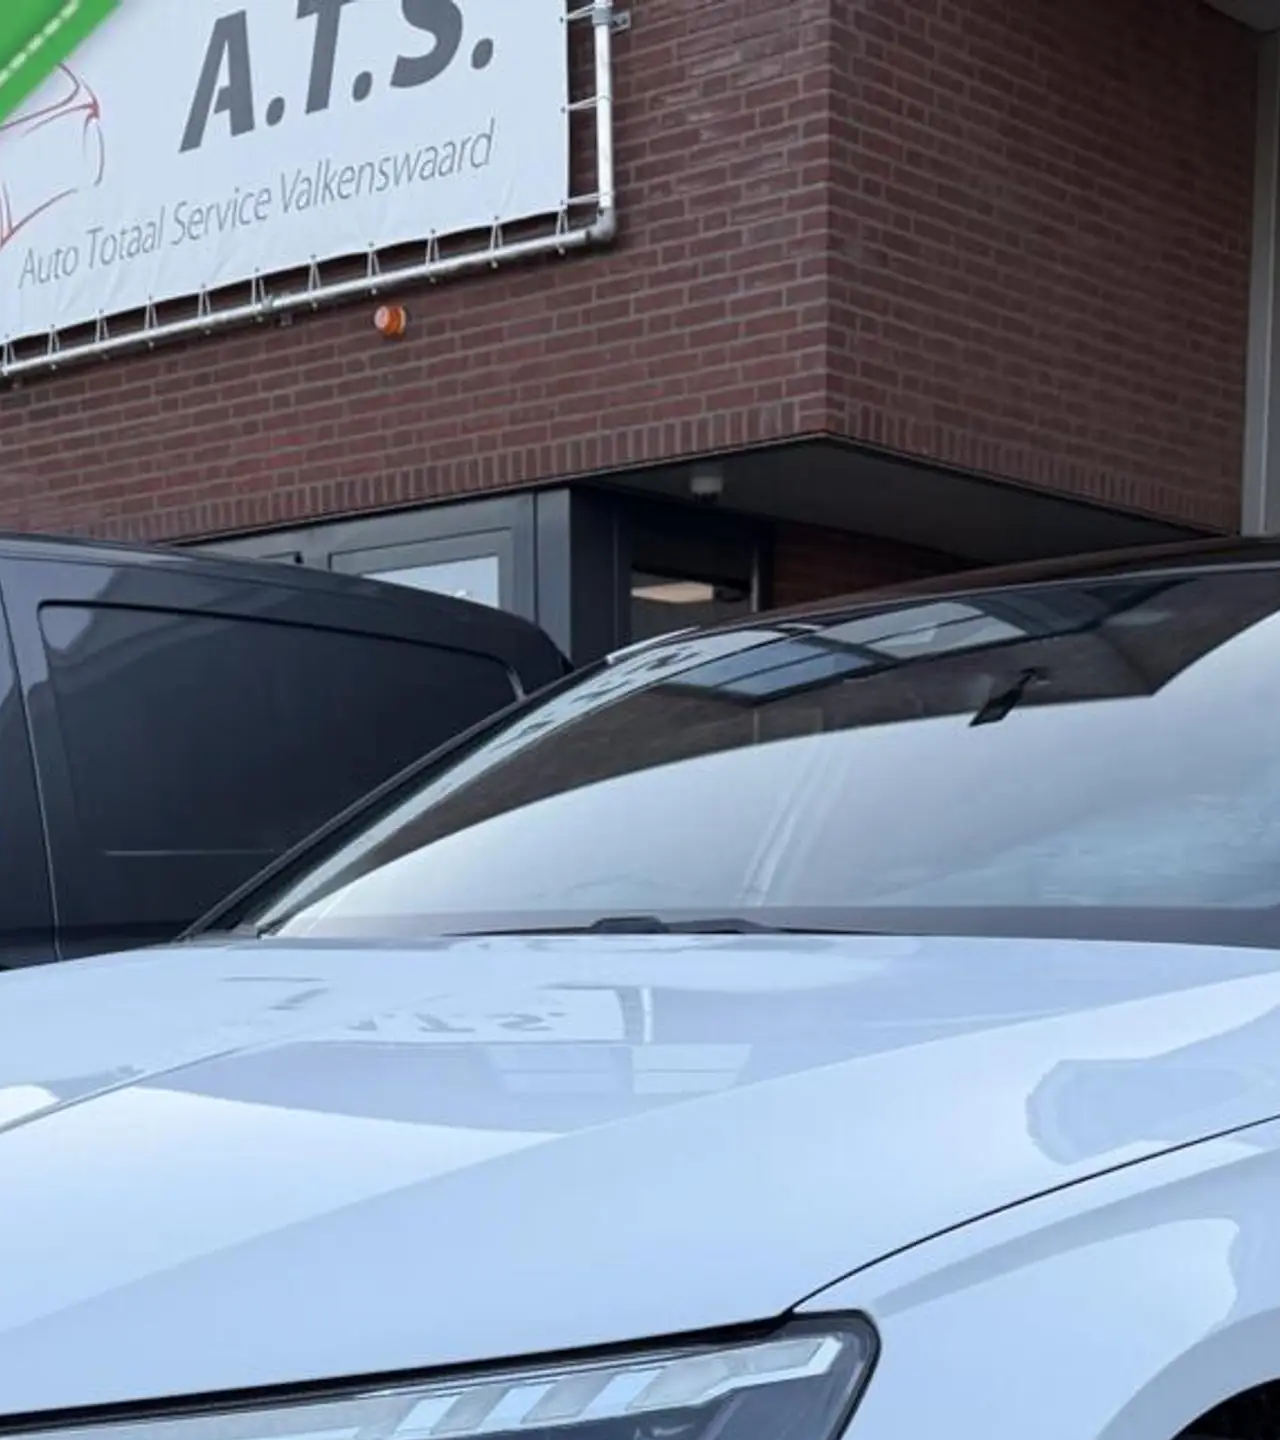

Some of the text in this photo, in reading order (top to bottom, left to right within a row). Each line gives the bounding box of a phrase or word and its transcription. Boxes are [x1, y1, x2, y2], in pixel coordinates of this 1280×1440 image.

[178, 0, 494, 153] A.T.S.
[18, 117, 495, 289] Auto Totaal Service Valkenswaard
